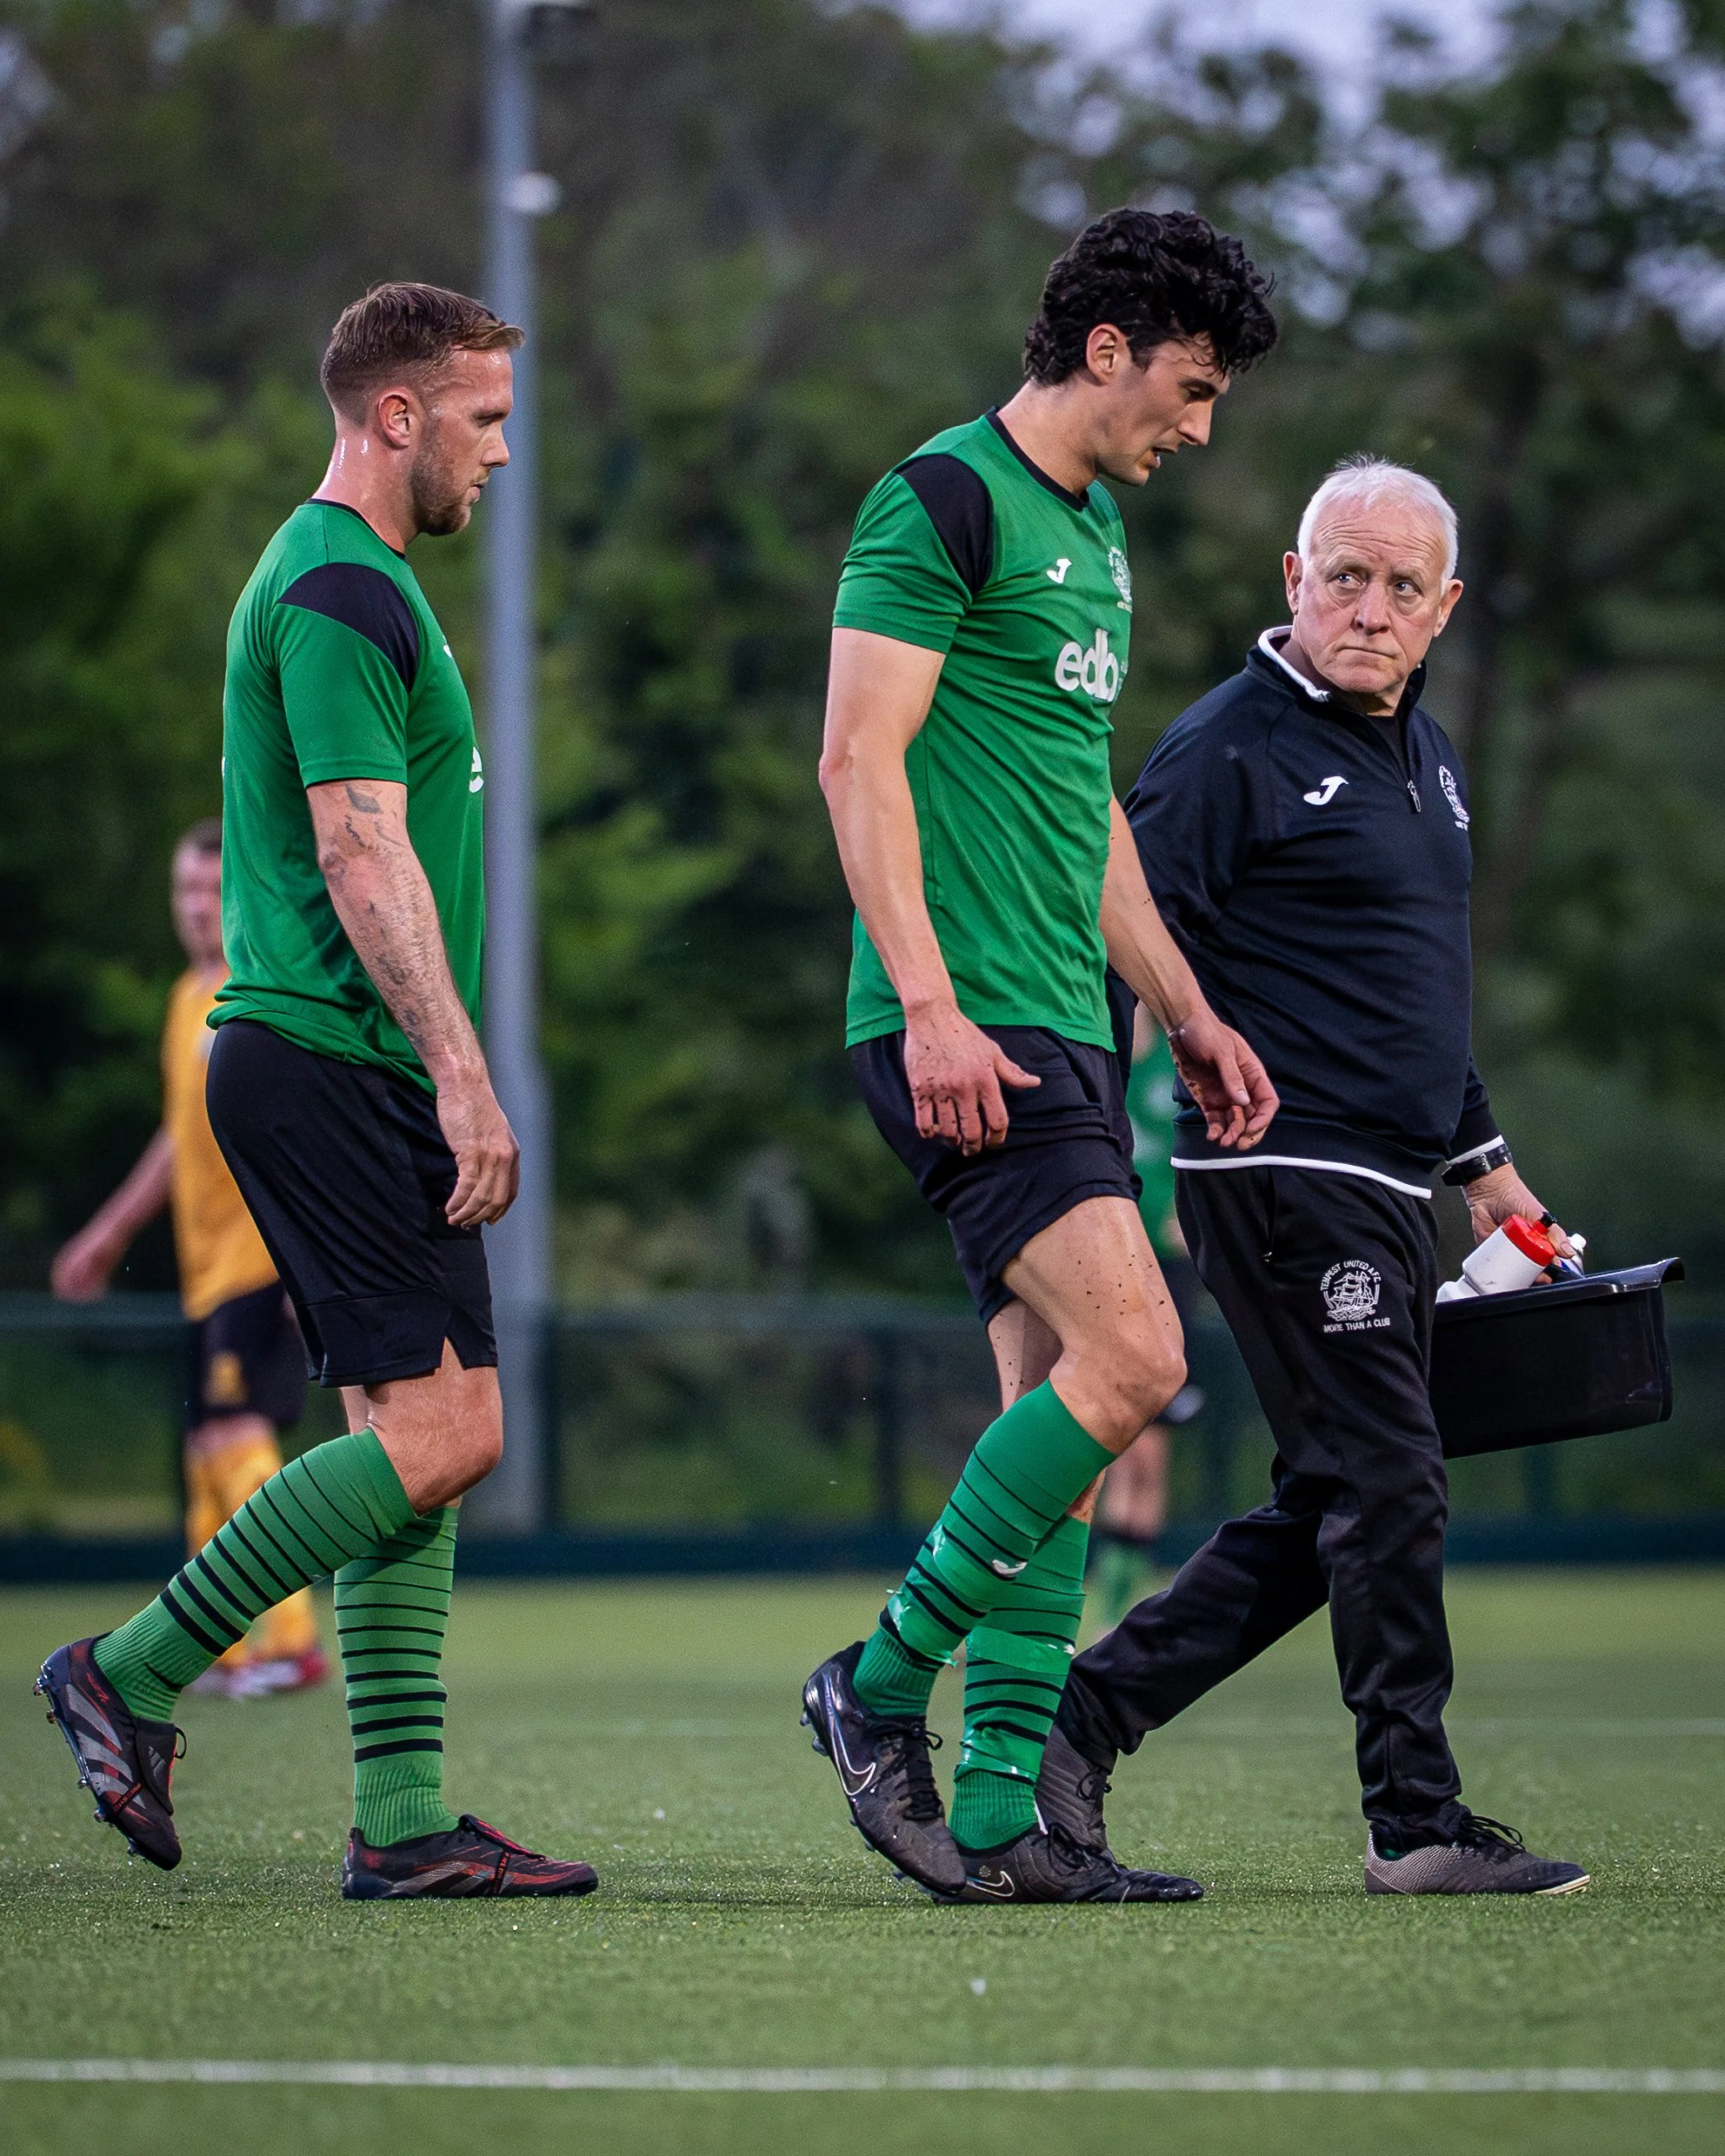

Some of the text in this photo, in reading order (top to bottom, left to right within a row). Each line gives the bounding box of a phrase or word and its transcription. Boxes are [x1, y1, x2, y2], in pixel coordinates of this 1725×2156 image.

[1055, 628, 1119, 702] edb
[1321, 1263, 1341, 1291] TEMPEST
[1343, 1260, 1369, 1270] UNITED
[1323, 1324, 1343, 1333] MORE
[1345, 1321, 1365, 1331] THAN
[1373, 1317, 1390, 1328] CLUB
